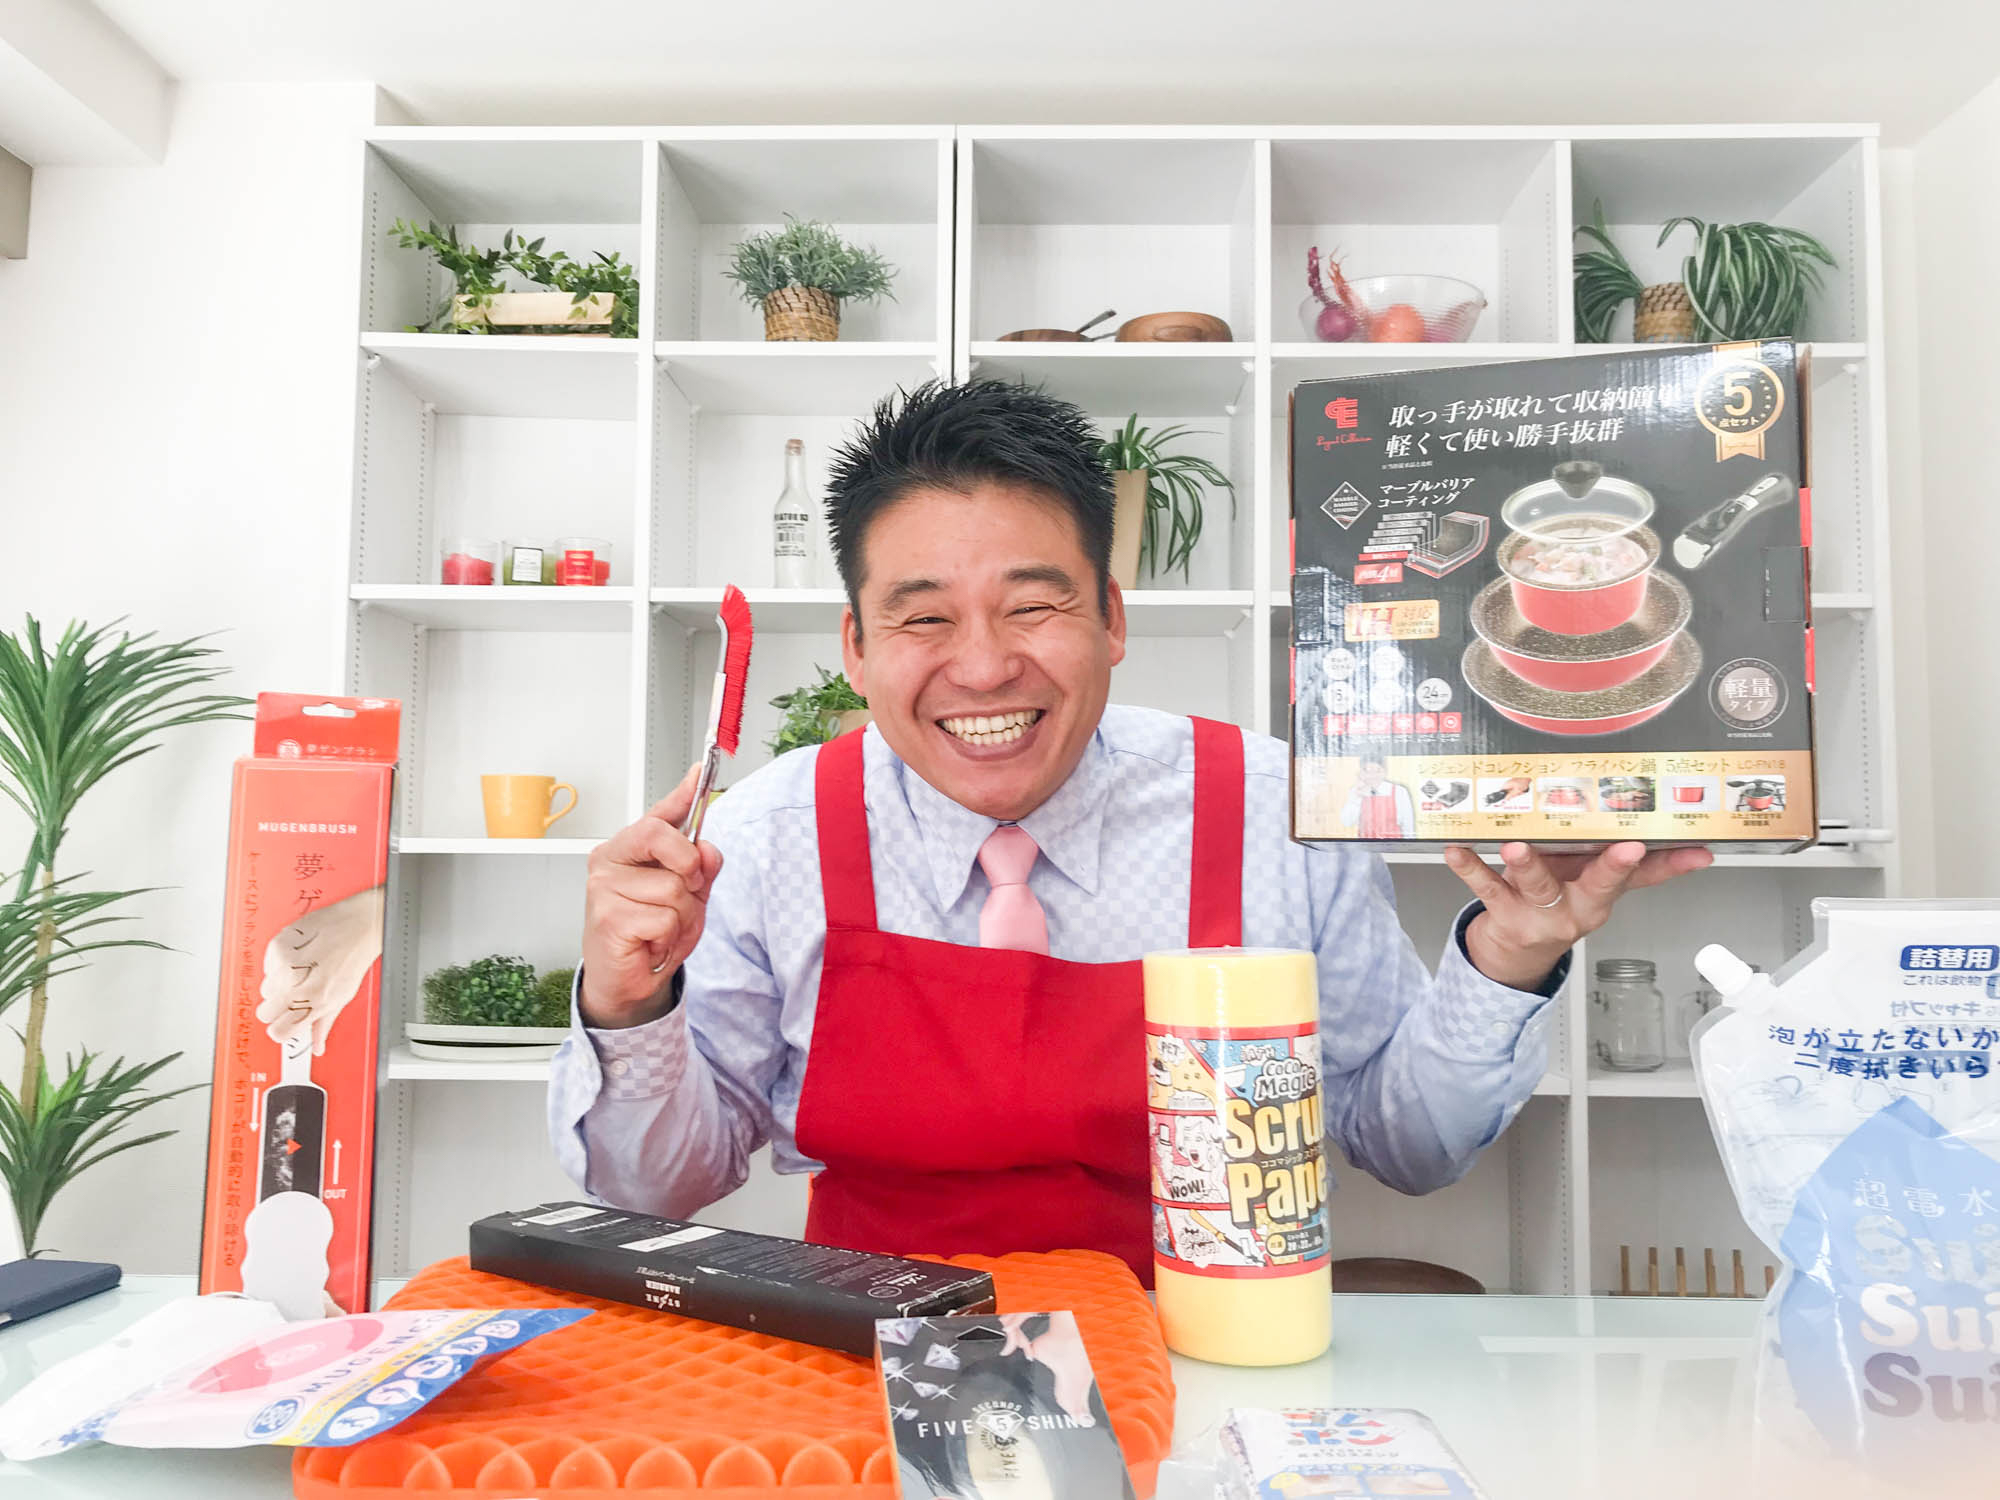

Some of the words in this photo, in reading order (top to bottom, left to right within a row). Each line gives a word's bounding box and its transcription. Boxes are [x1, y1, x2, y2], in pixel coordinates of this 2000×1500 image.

[1724, 371, 1753, 416] 5
[1719, 417, 1761, 429] 点セット
[1385, 417, 1624, 458] 軽くて使い勝手抜群
[1379, 477, 1476, 495] マーブルバリア
[1377, 491, 1462, 509] コーティング
[1723, 677, 1774, 699] 軽量
[1728, 700, 1771, 713] タイプ
[258, 822, 357, 834] MUGENBRUSH
[288, 853, 325, 1060] 夢ゲンブラシ
[1908, 947, 1993, 968] 詰替用
[1769, 1024, 2000, 1052] 泡が立たないか
[251, 1072, 268, 1083] IN
[323, 1189, 346, 1199] OUT
[1852, 1177, 2000, 1218] 超電水
[917, 1418, 976, 1439] FIVE
